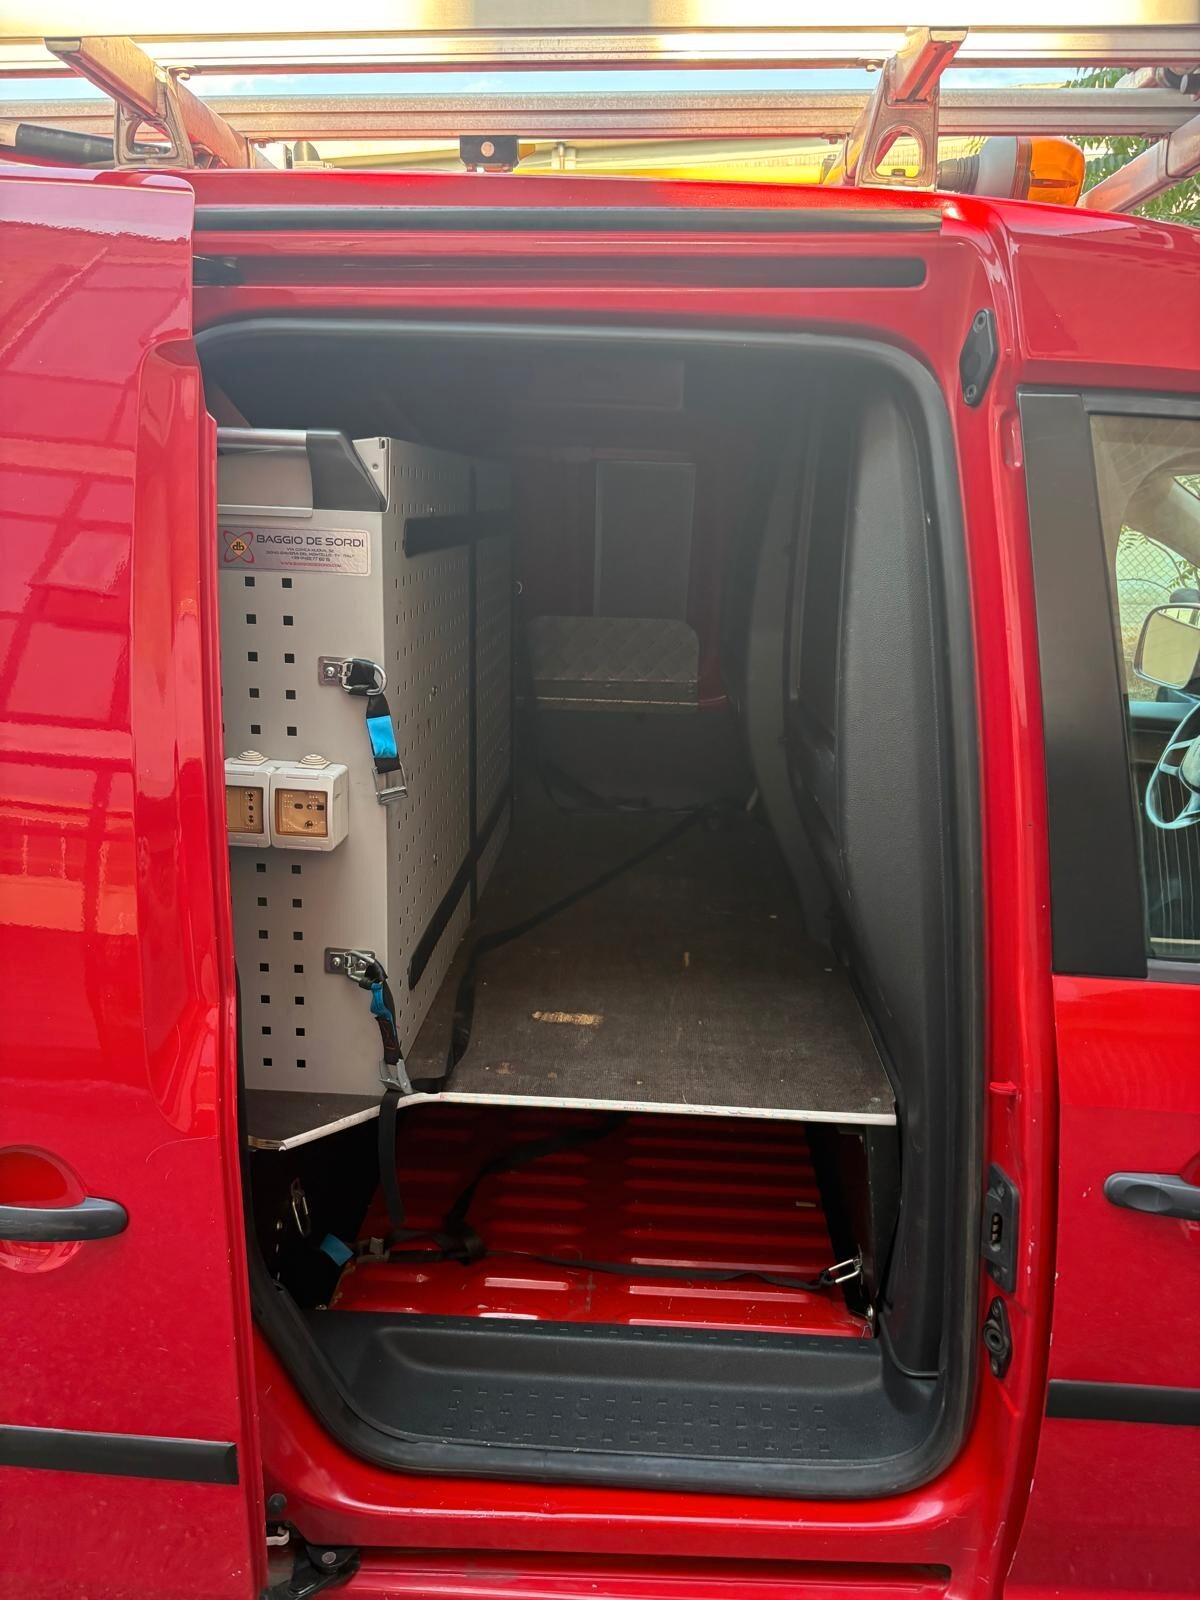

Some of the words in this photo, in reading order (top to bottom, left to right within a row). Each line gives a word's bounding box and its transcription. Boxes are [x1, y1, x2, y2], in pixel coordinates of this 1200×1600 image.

[256, 535, 303, 545] BAGGIO
[306, 536, 322, 546] DE
[325, 537, 364, 548] SORDI
